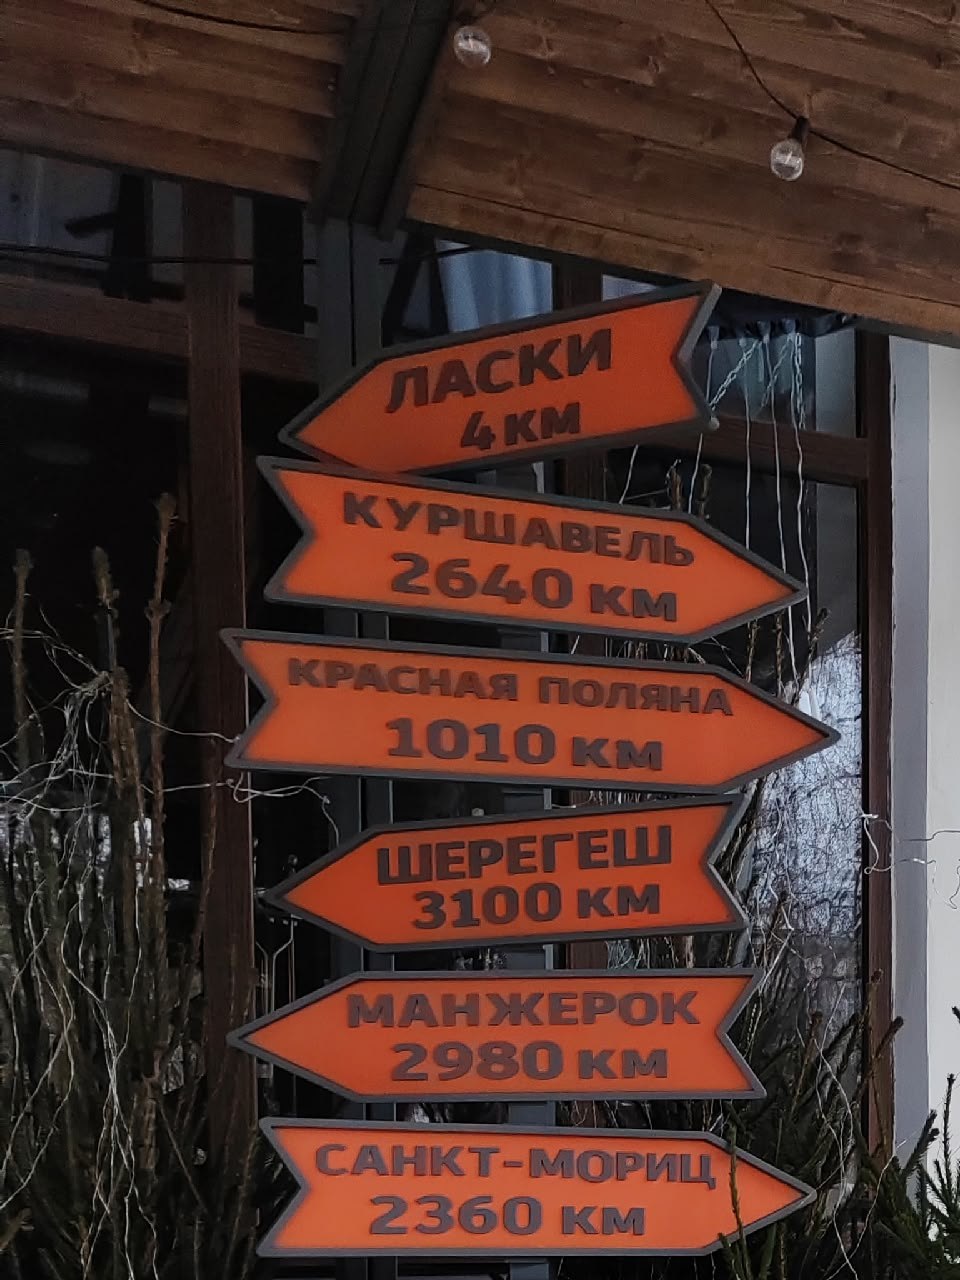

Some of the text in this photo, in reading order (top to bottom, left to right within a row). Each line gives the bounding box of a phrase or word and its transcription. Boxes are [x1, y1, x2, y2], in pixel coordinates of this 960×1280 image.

[384, 328, 611, 414] ЛАСКИ
[461, 411, 496, 450] 4
[344, 491, 696, 567] КУРШАВЕЛЬ
[390, 553, 573, 609] 2640
[288, 657, 733, 715] КРАСНАЯ ПОЛЯНА
[387, 718, 556, 764] 1010
[377, 825, 671, 885] ШЕРЕГЕШ
[412, 882, 561, 929] 3100
[347, 991, 699, 1027] МАНЖЕРОК
[392, 1042, 563, 1081] 2980
[316, 1143, 716, 1189] САНКТ-МОРИЦ
[370, 1196, 542, 1235] 2360
